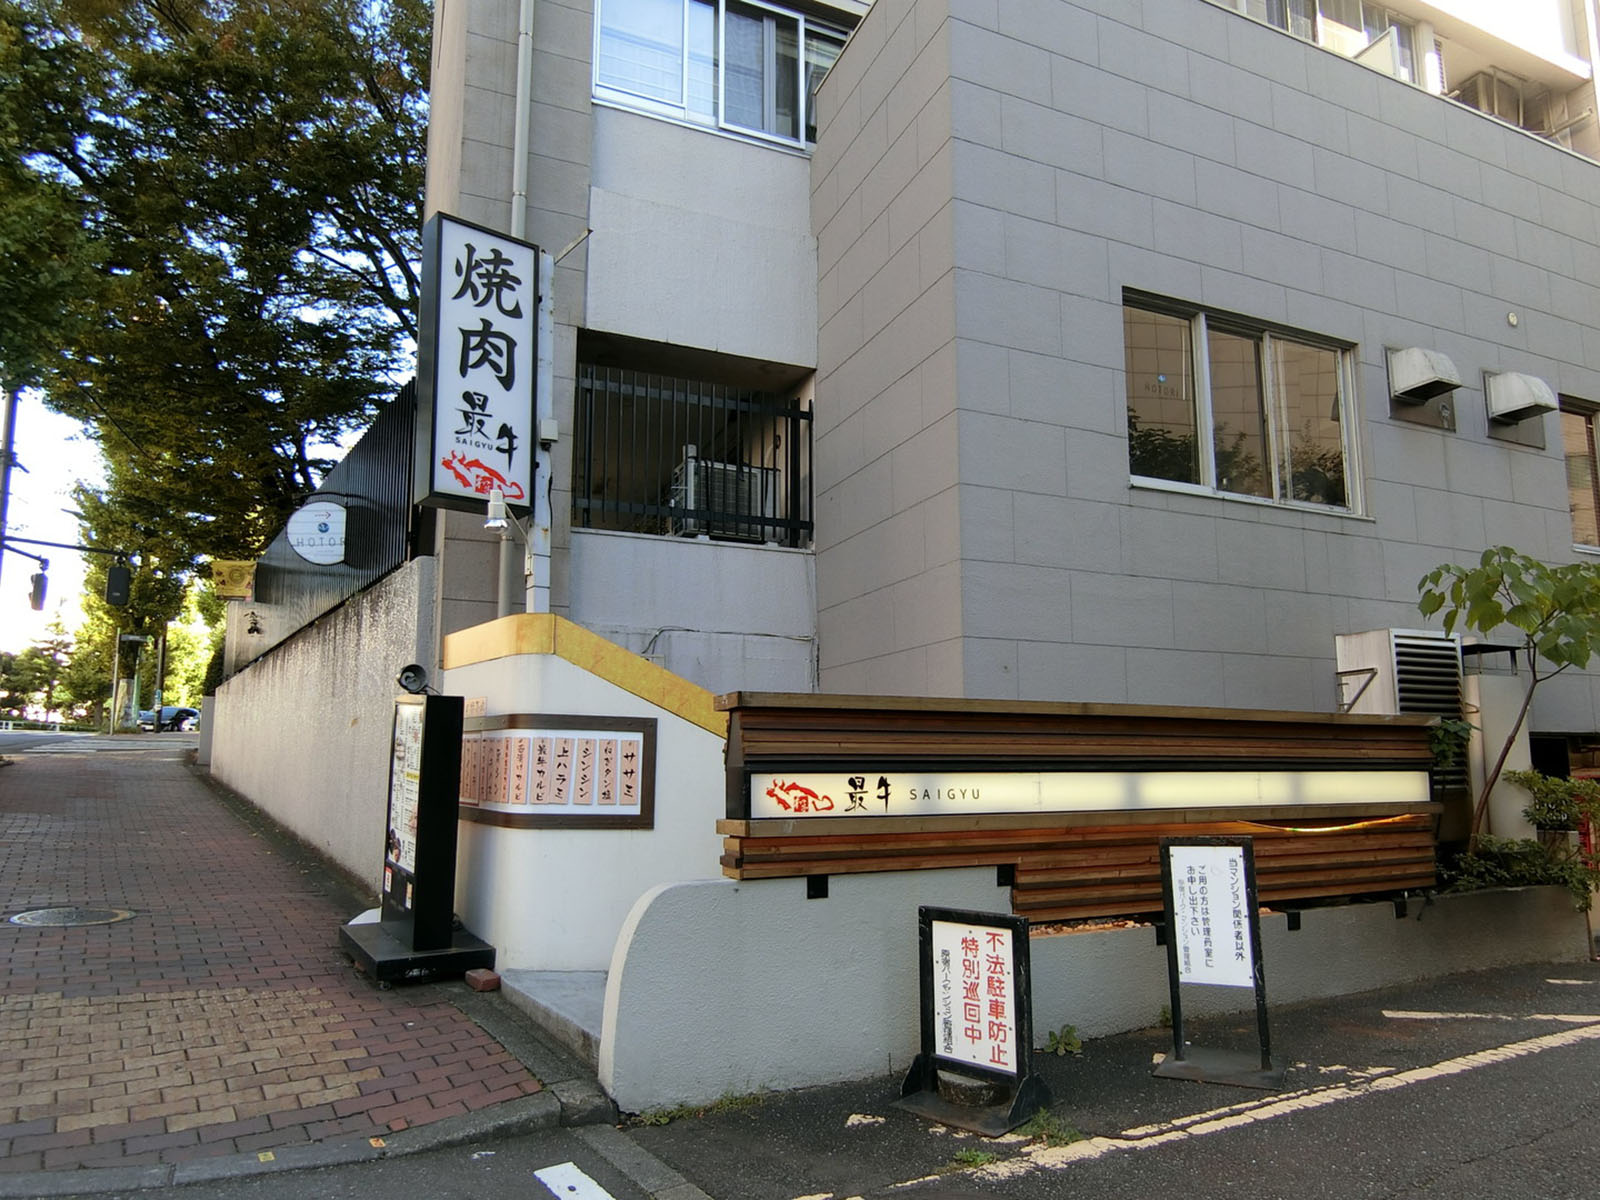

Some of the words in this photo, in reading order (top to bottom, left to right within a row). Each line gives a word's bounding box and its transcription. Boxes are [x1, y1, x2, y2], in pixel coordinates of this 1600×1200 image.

[452, 243, 523, 391] 焼肉
[454, 390, 519, 472] 最牛
[455, 436, 494, 451] SAIGYU
[554, 746, 569, 799] 上ハラミ
[579, 747, 592, 799] シンシン
[622, 751, 636, 798] ササミ
[844, 776, 892, 813] 最牛
[909, 788, 981, 801] SAIGYU
[1186, 865, 1200, 936] お申し出下さい
[1228, 858, 1245, 961] 当マンション関係者以外
[960, 936, 982, 1045] 特別巡回中
[985, 931, 1009, 1067] 不法駐車防止
